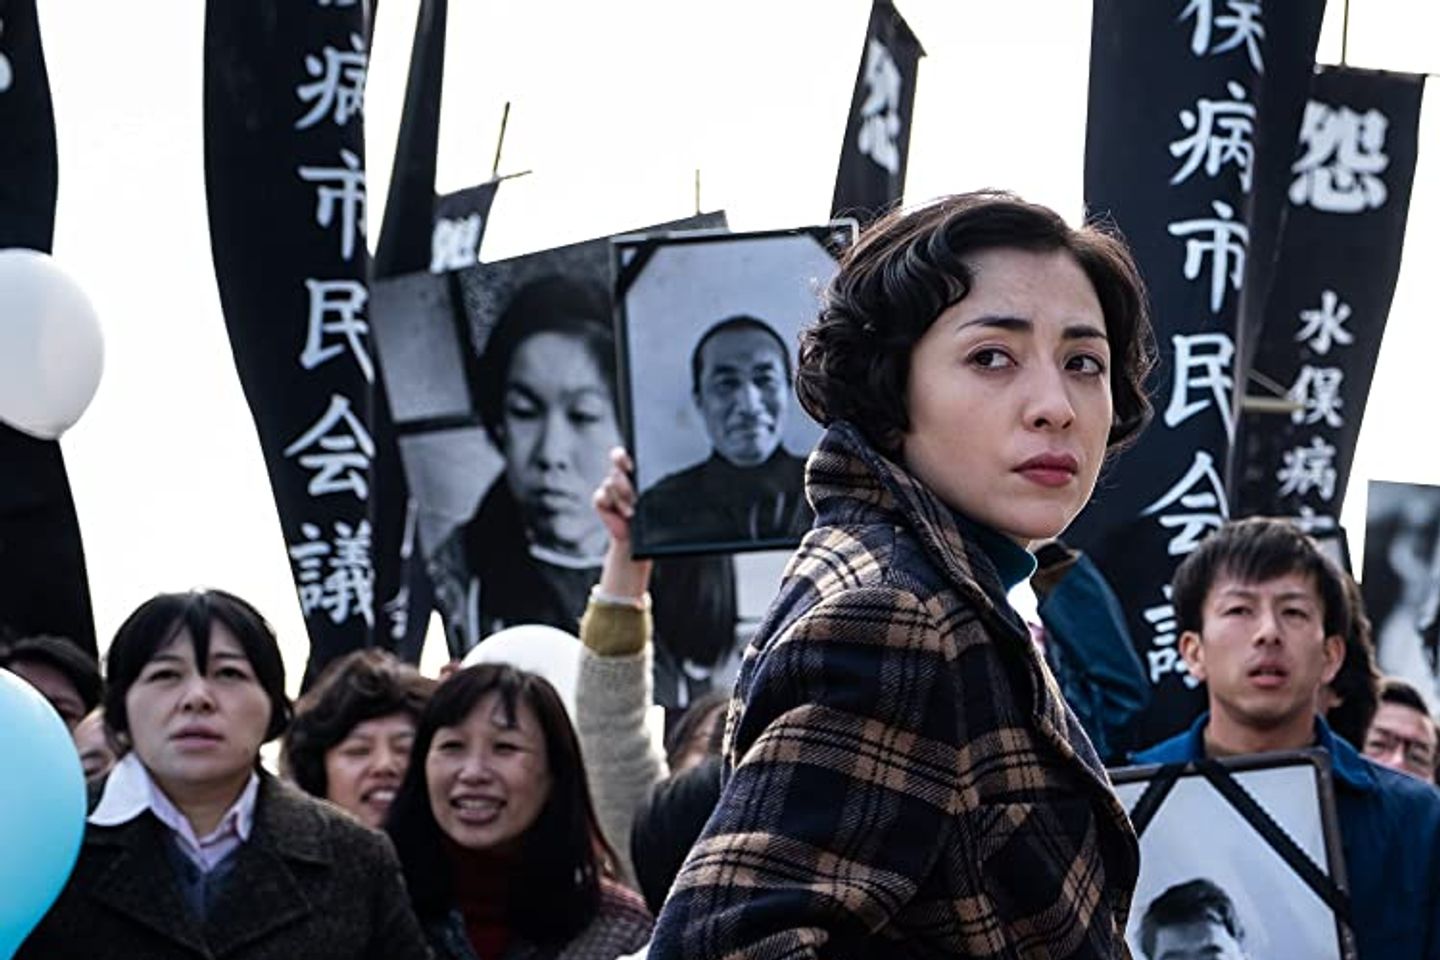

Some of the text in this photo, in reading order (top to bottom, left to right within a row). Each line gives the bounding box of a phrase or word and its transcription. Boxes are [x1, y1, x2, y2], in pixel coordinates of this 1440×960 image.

[283, 0, 375, 627] 病市民会議
[1289, 102, 1389, 212] 怨
